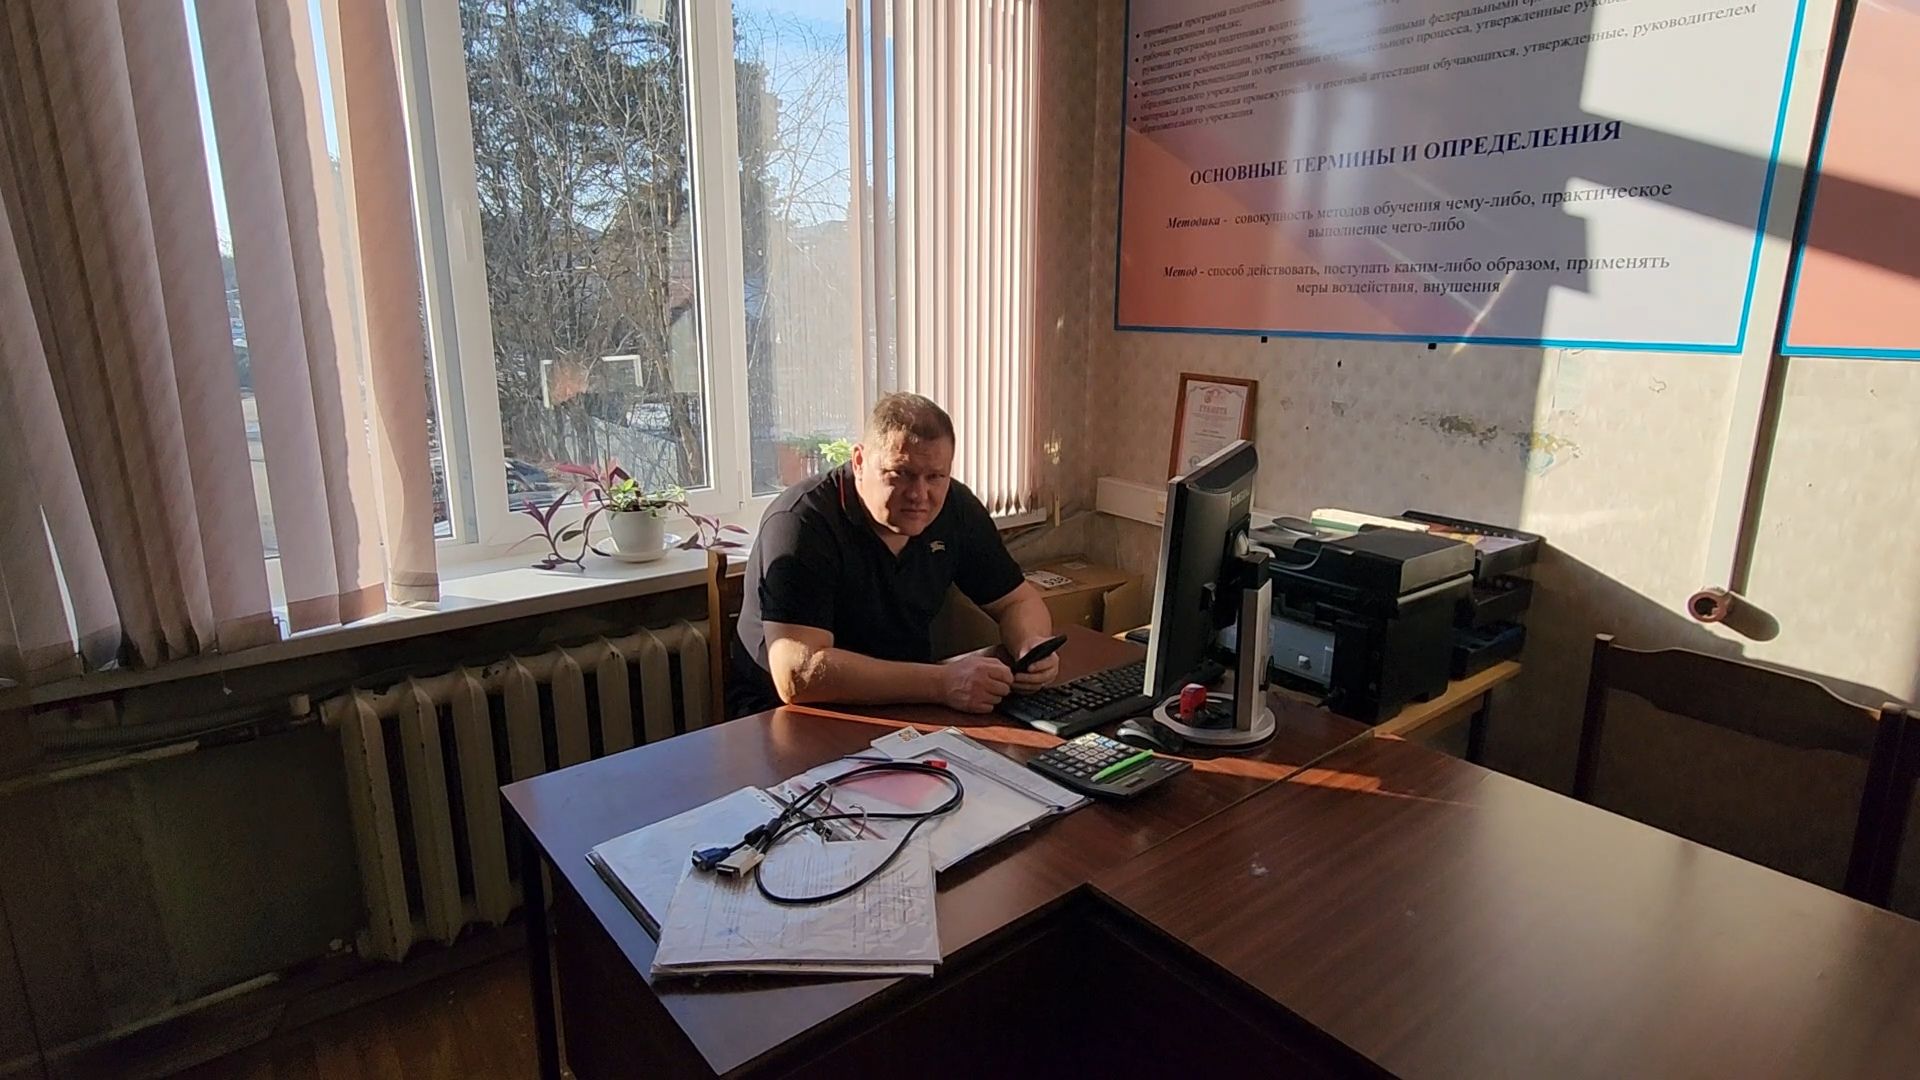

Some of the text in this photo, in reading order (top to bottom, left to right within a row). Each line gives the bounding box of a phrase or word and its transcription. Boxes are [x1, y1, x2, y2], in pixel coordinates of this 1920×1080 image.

[1476, 5, 1571, 33] утвержденные
[1632, 4, 1757, 38] руководителем
[1190, 120, 1623, 186] ОСНОВНЫЕ ТЕРМИНЫ И ОПРЕДЕЛЕНИЯ
[1167, 215, 1221, 230] Методика
[1234, 208, 1314, 227] совокупность
[1317, 203, 1370, 219] методов
[1373, 198, 1441, 217] обучения
[1445, 188, 1536, 213] чему-либо,
[1541, 181, 1673, 206] практическое
[1308, 217, 1466, 239] выполнение чего-либо
[1163, 264, 1198, 279] Метод
[1207, 263, 1245, 277] способ
[1247, 264, 1320, 278] действовать,
[1324, 262, 1390, 279] поступать
[1394, 258, 1482, 274] каким-либо
[1486, 255, 1560, 275] образом,
[1566, 254, 1671, 275] применять
[1296, 279, 1501, 296] меры воздействия, внушения
